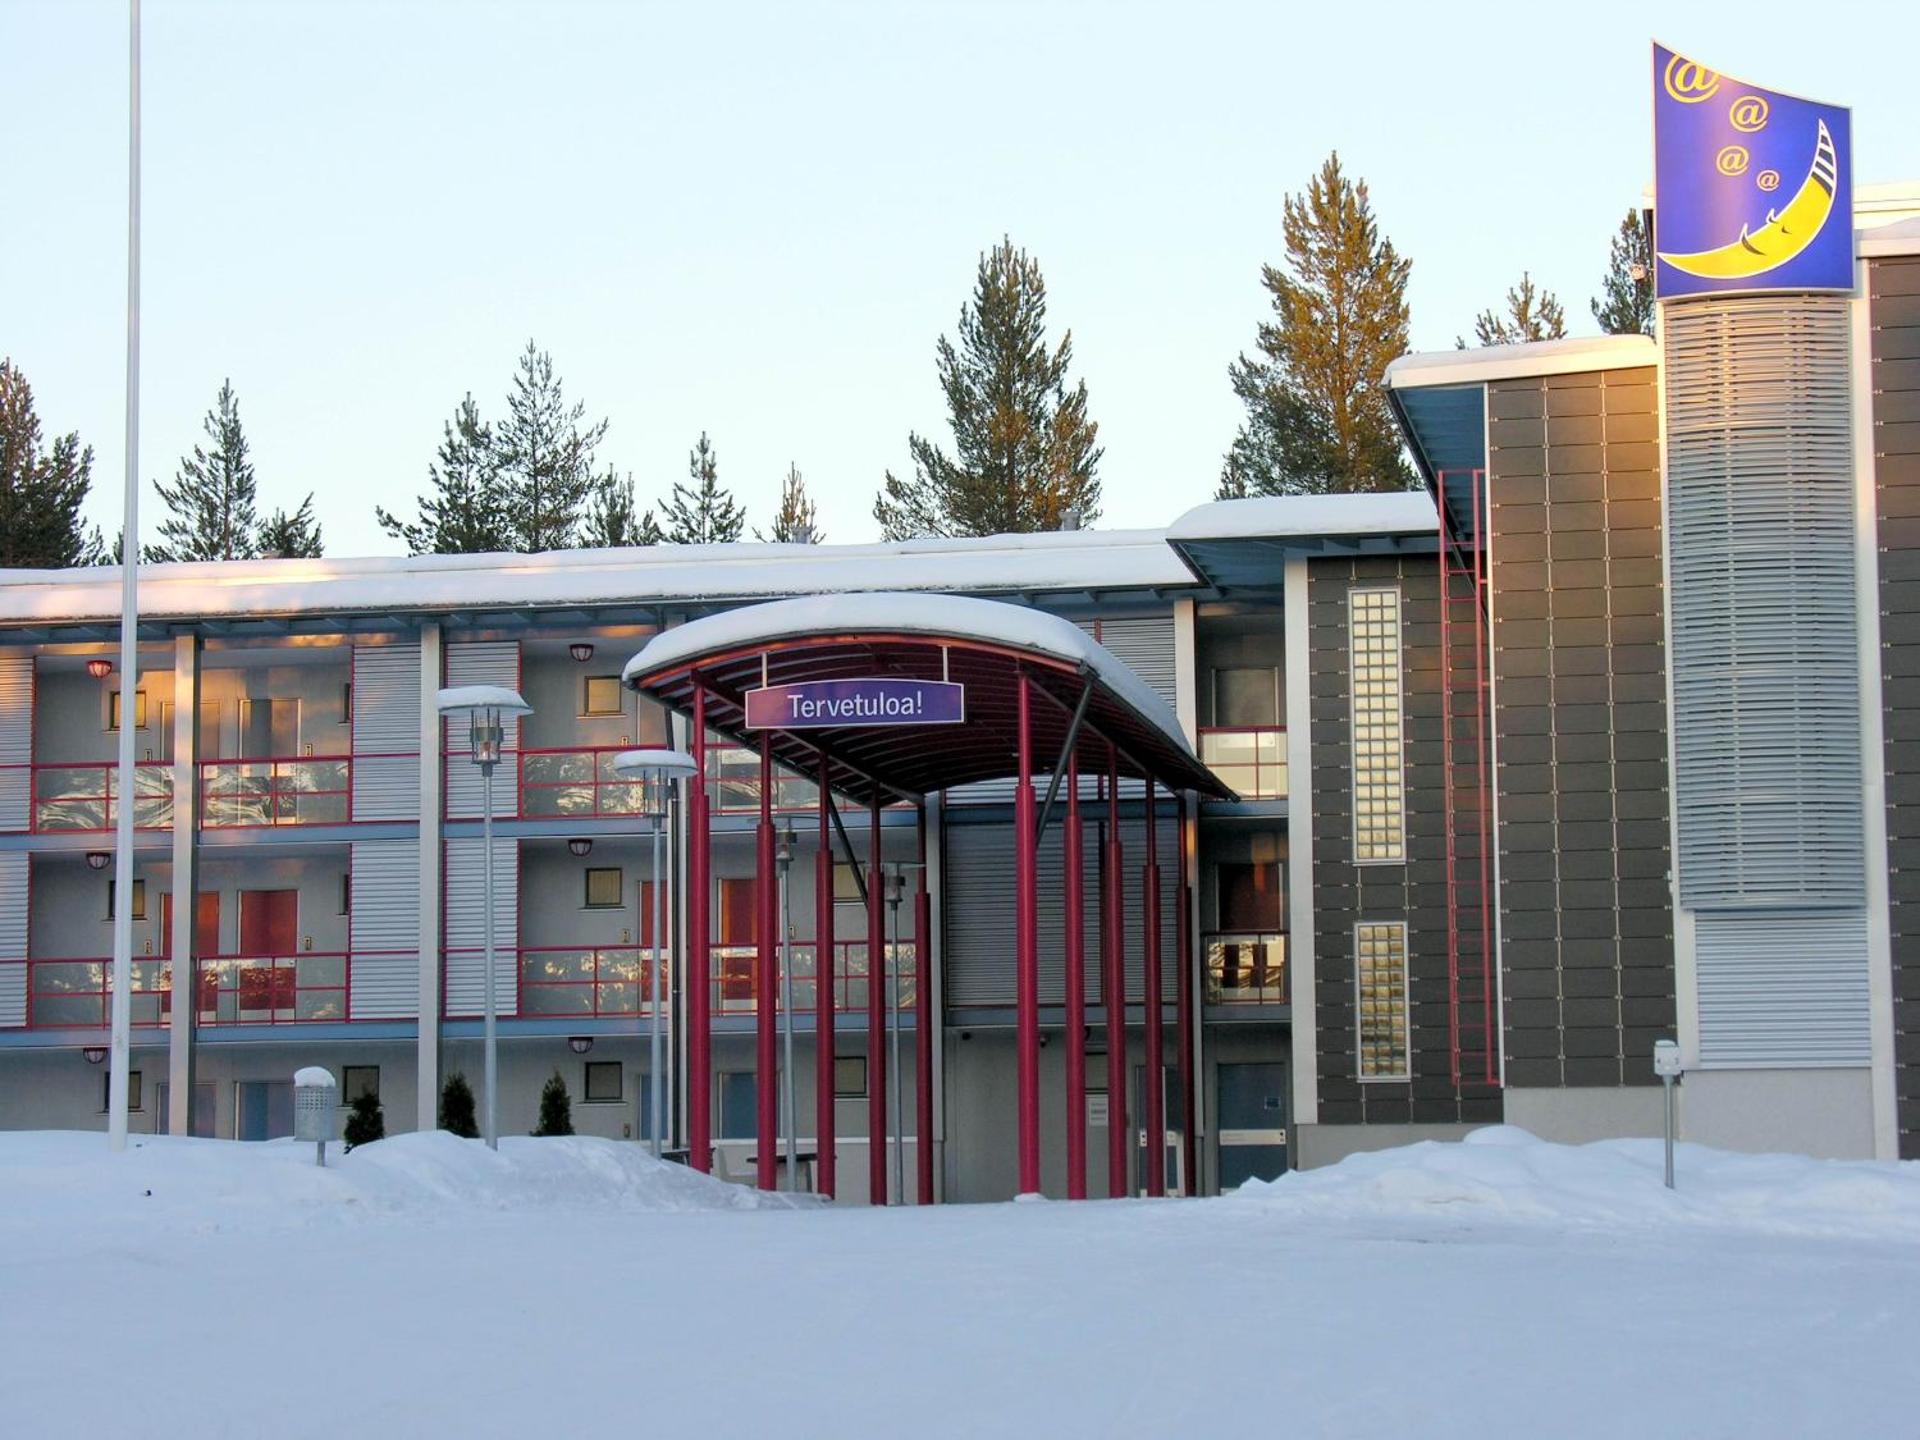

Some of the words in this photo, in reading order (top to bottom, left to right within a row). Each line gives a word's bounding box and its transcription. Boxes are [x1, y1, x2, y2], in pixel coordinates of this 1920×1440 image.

[1664, 53, 1721, 104] @
[1729, 95, 1769, 133] @
[1716, 145, 1749, 176] @
[1756, 169, 1780, 191] @
[787, 690, 923, 718] Tervetuloa!
